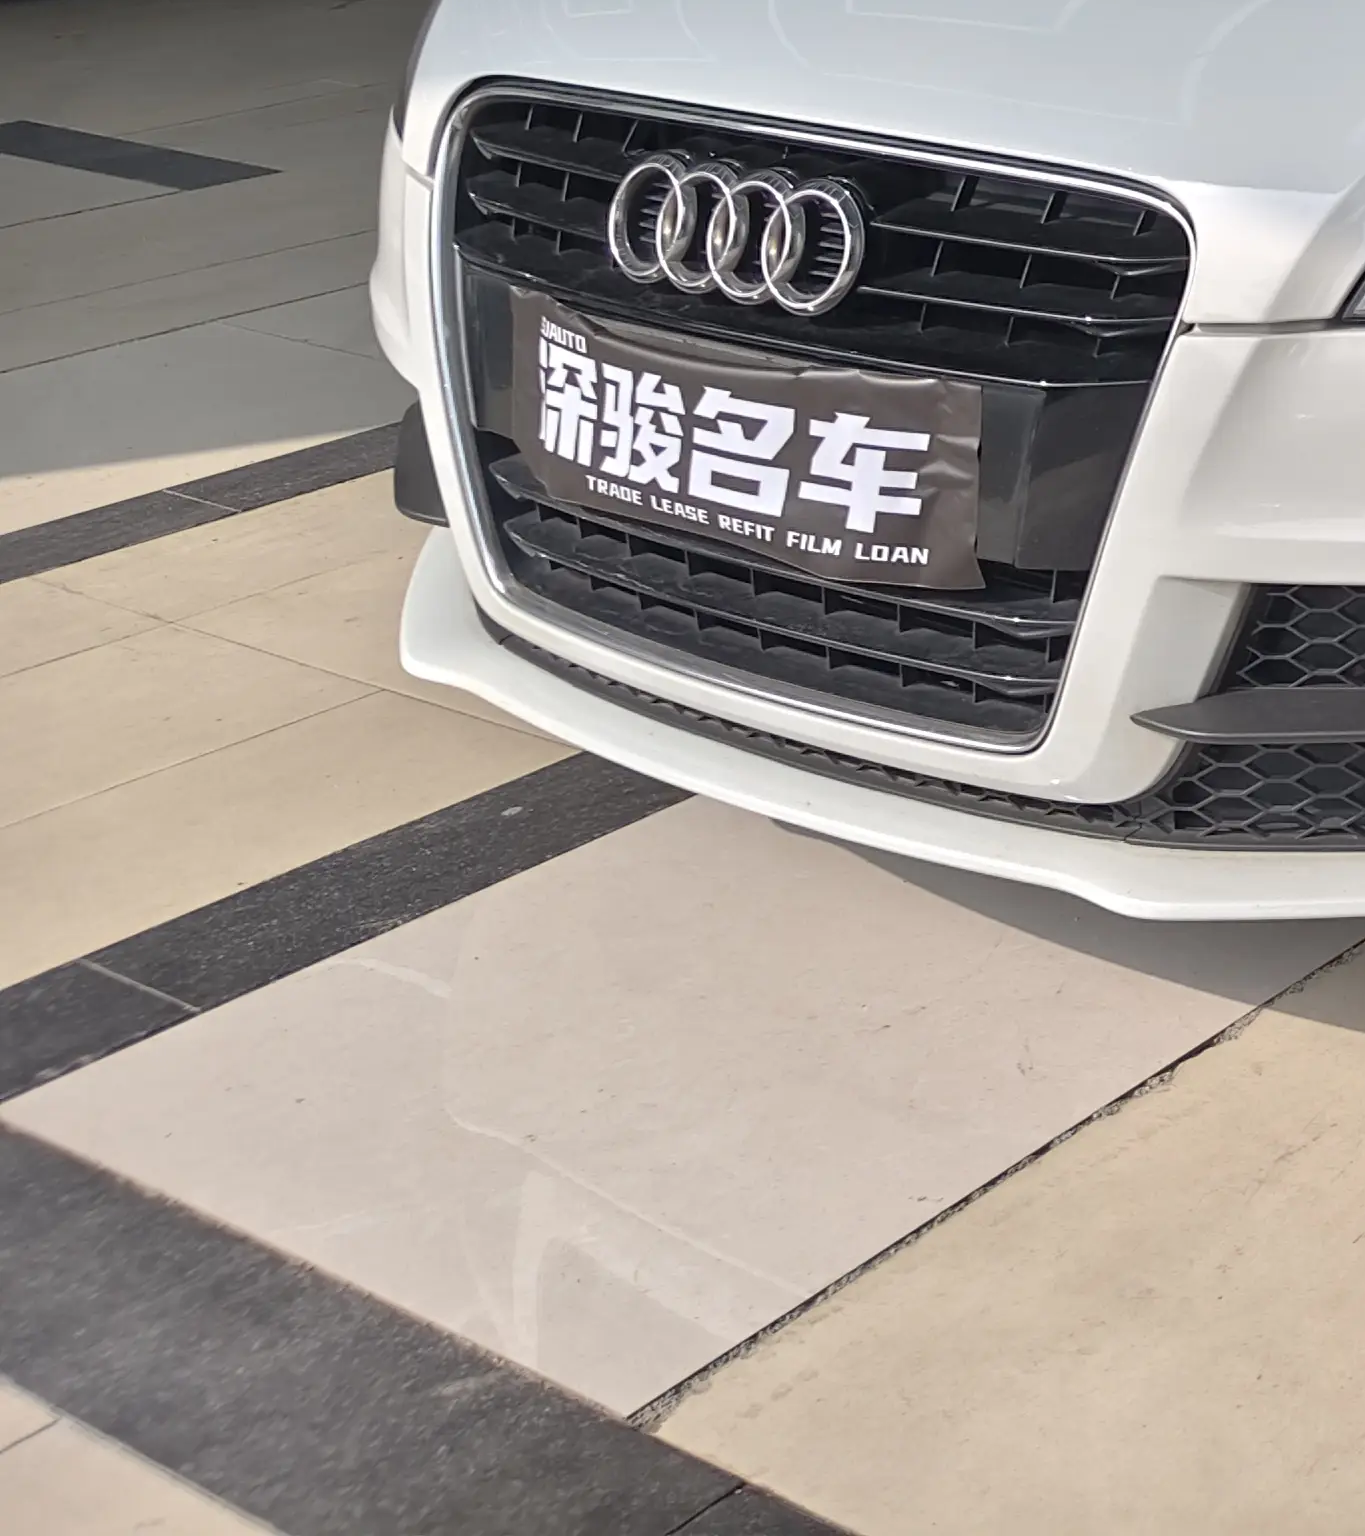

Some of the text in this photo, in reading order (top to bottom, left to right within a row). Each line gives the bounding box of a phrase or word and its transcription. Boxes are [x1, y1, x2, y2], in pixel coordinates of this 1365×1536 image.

[538, 335, 933, 534] 深骏名车
[584, 474, 930, 566] TRADE LEASE REFIT FILM LOAN
